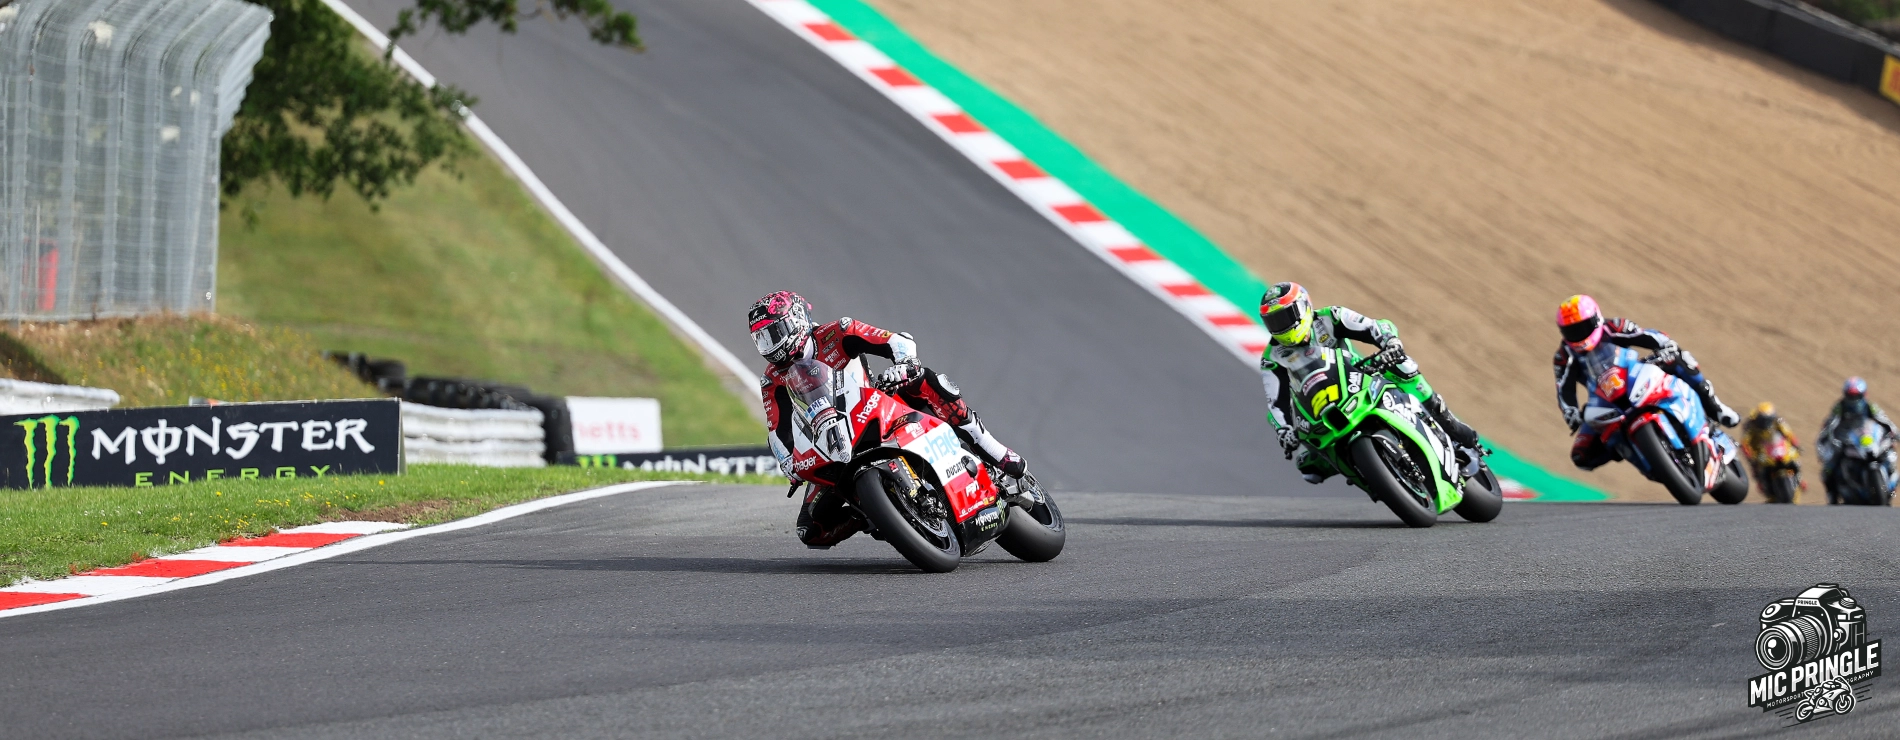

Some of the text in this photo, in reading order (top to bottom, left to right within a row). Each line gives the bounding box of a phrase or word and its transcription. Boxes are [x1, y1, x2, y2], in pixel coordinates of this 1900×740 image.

[1311, 384, 1338, 418] 21
[90, 415, 375, 465] MONSTER
[825, 424, 846, 457] 4
[135, 465, 331, 487] ENERGY
